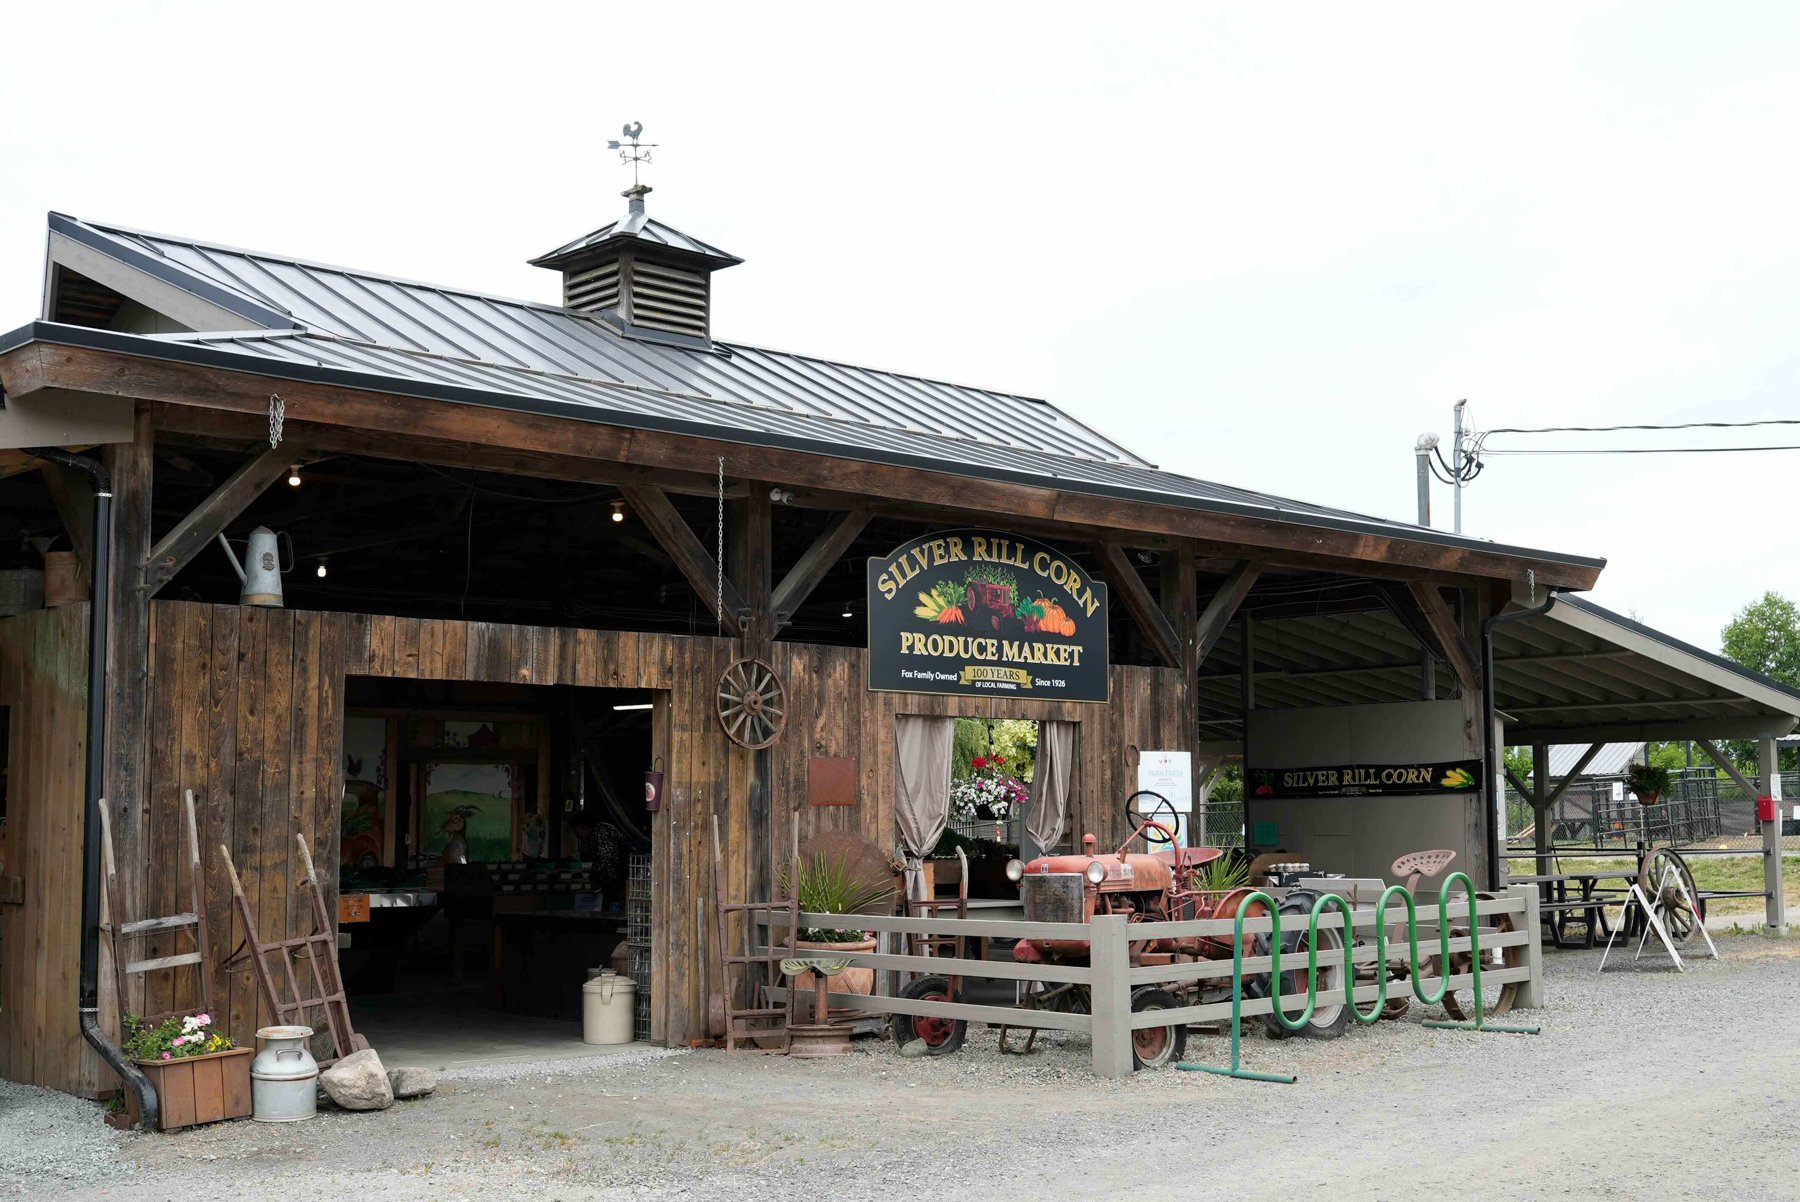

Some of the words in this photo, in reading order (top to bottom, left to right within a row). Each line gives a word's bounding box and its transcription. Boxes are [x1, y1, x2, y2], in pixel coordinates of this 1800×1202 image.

[877, 536, 967, 600] SILVER
[972, 536, 1030, 570] RILL
[1034, 552, 1100, 618] CORN
[900, 631, 998, 661] PRODUCE
[1001, 639, 1083, 667] MARKET
[901, 669, 913, 679] Fox
[913, 671, 934, 681] Family
[935, 671, 957, 681] Owned
[972, 668, 989, 679] 100
[990, 669, 1020, 681] YEARS
[996, 682, 1017, 690] FARMING
[1035, 678, 1051, 687] Since
[1051, 679, 1066, 688] 1926
[1283, 770, 1340, 788] SILVER
[1342, 768, 1381, 785] RILL
[1381, 768, 1433, 785] CORN
